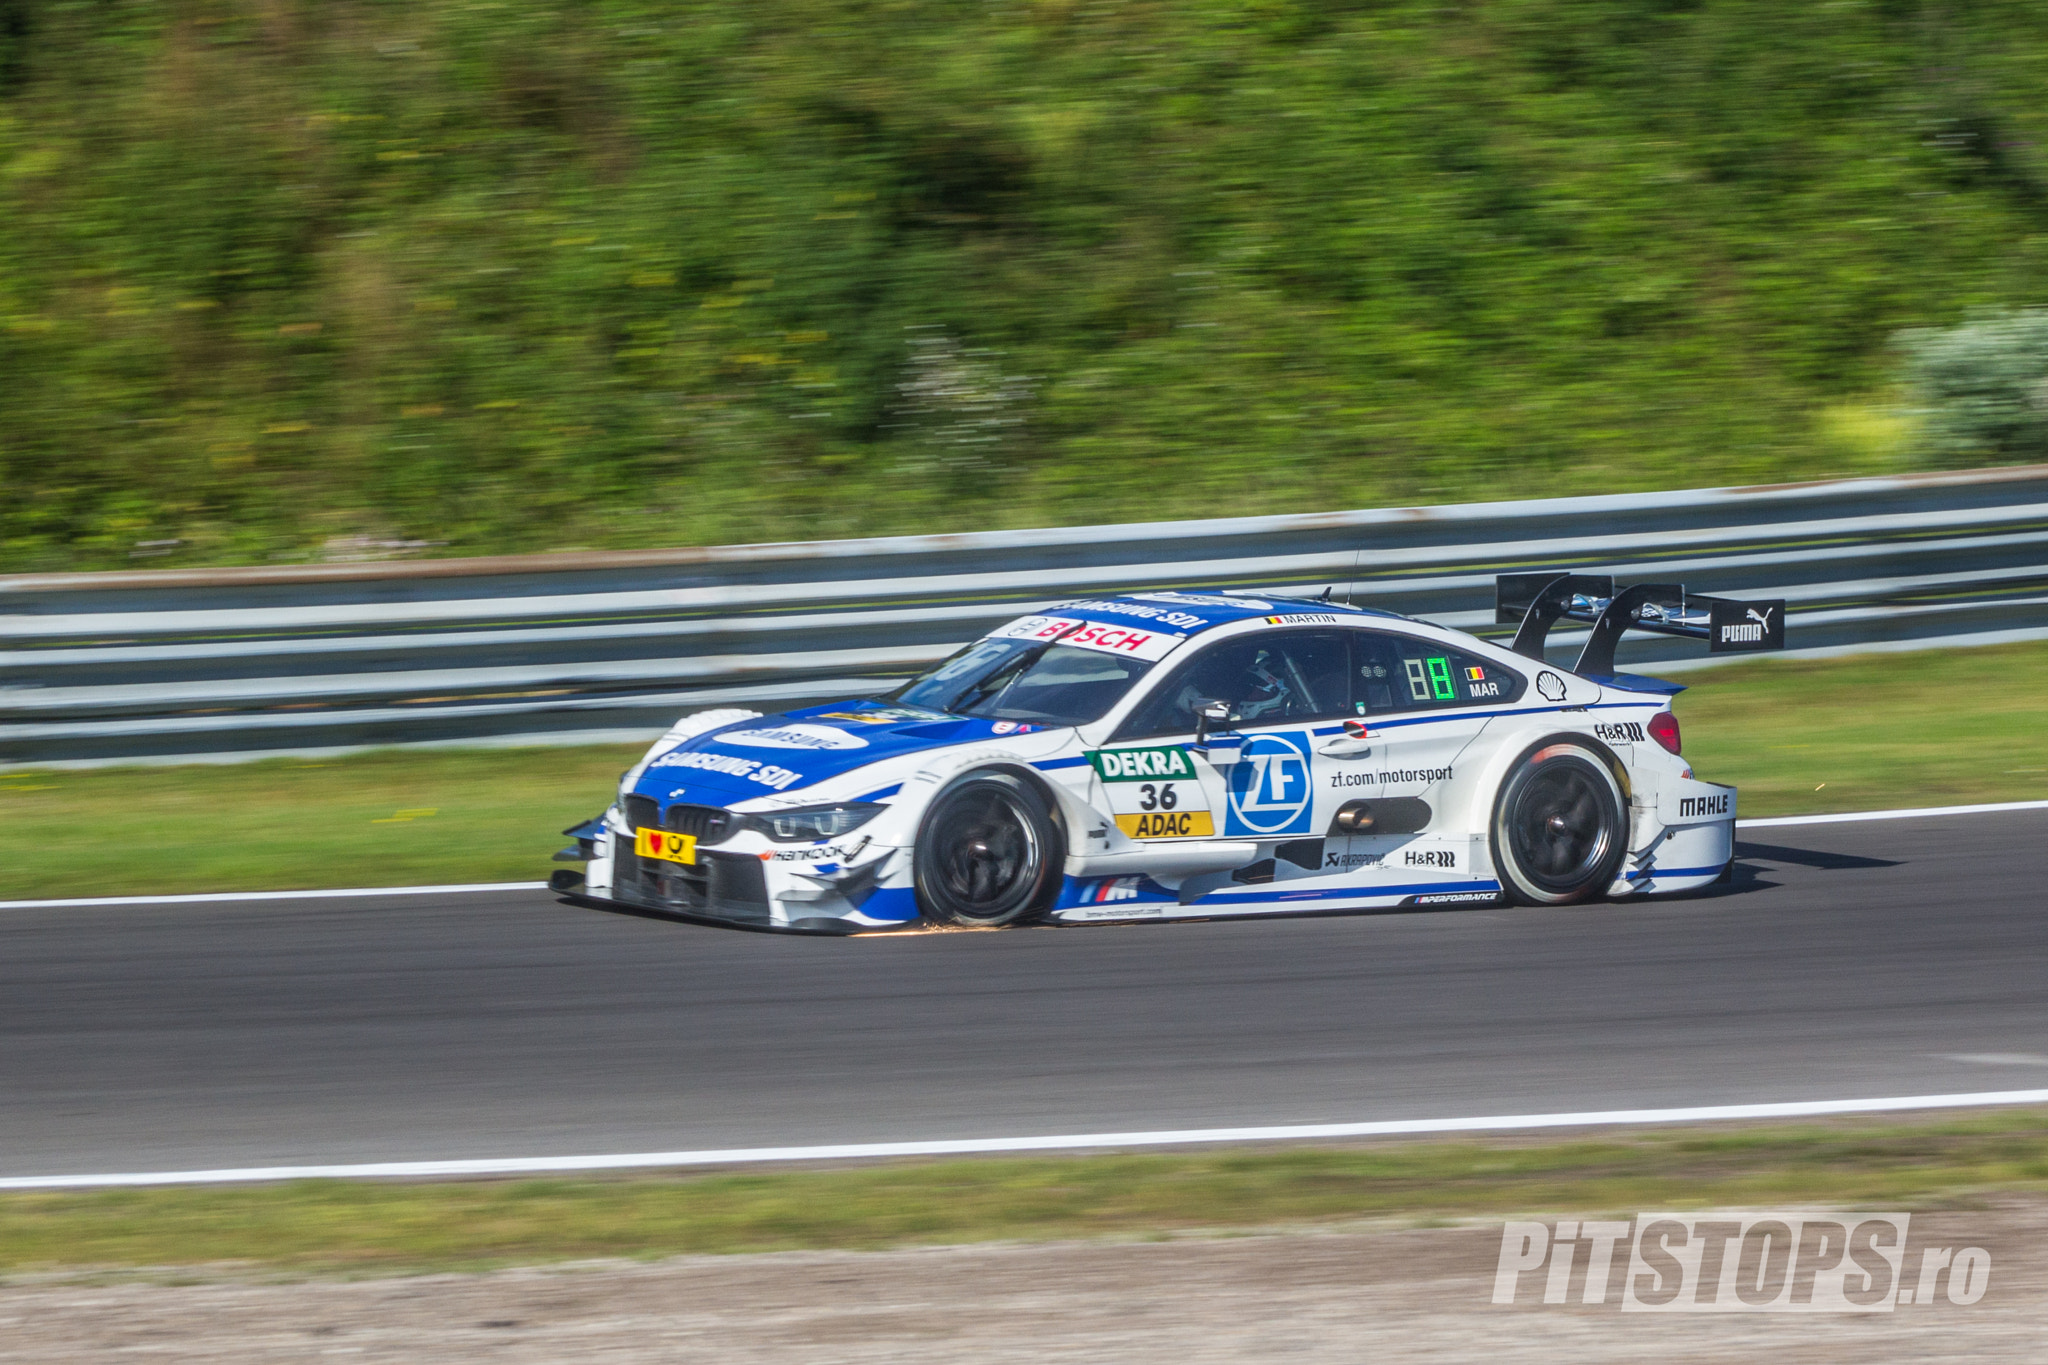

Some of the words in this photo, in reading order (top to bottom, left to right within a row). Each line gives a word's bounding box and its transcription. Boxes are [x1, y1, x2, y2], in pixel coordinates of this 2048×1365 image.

[1156, 611, 1208, 630] SDI
[1282, 614, 1337, 624] MARTIN
[1036, 621, 1153, 651] BOSCH
[1721, 623, 1762, 643] PUMA
[1469, 682, 1500, 698] MAR
[1593, 722, 1628, 740] H&R
[650, 752, 763, 777] SAMSUNG
[748, 765, 804, 791] SDI
[1100, 749, 1188, 777] DEKRA
[1240, 753, 1303, 812] ZF
[1330, 765, 1454, 789] zf.com/motorsport
[1139, 783, 1178, 811] 36
[1679, 794, 1728, 817] MAHLE
[1135, 813, 1192, 837] ADAC
[1404, 850, 1436, 866] H&R
